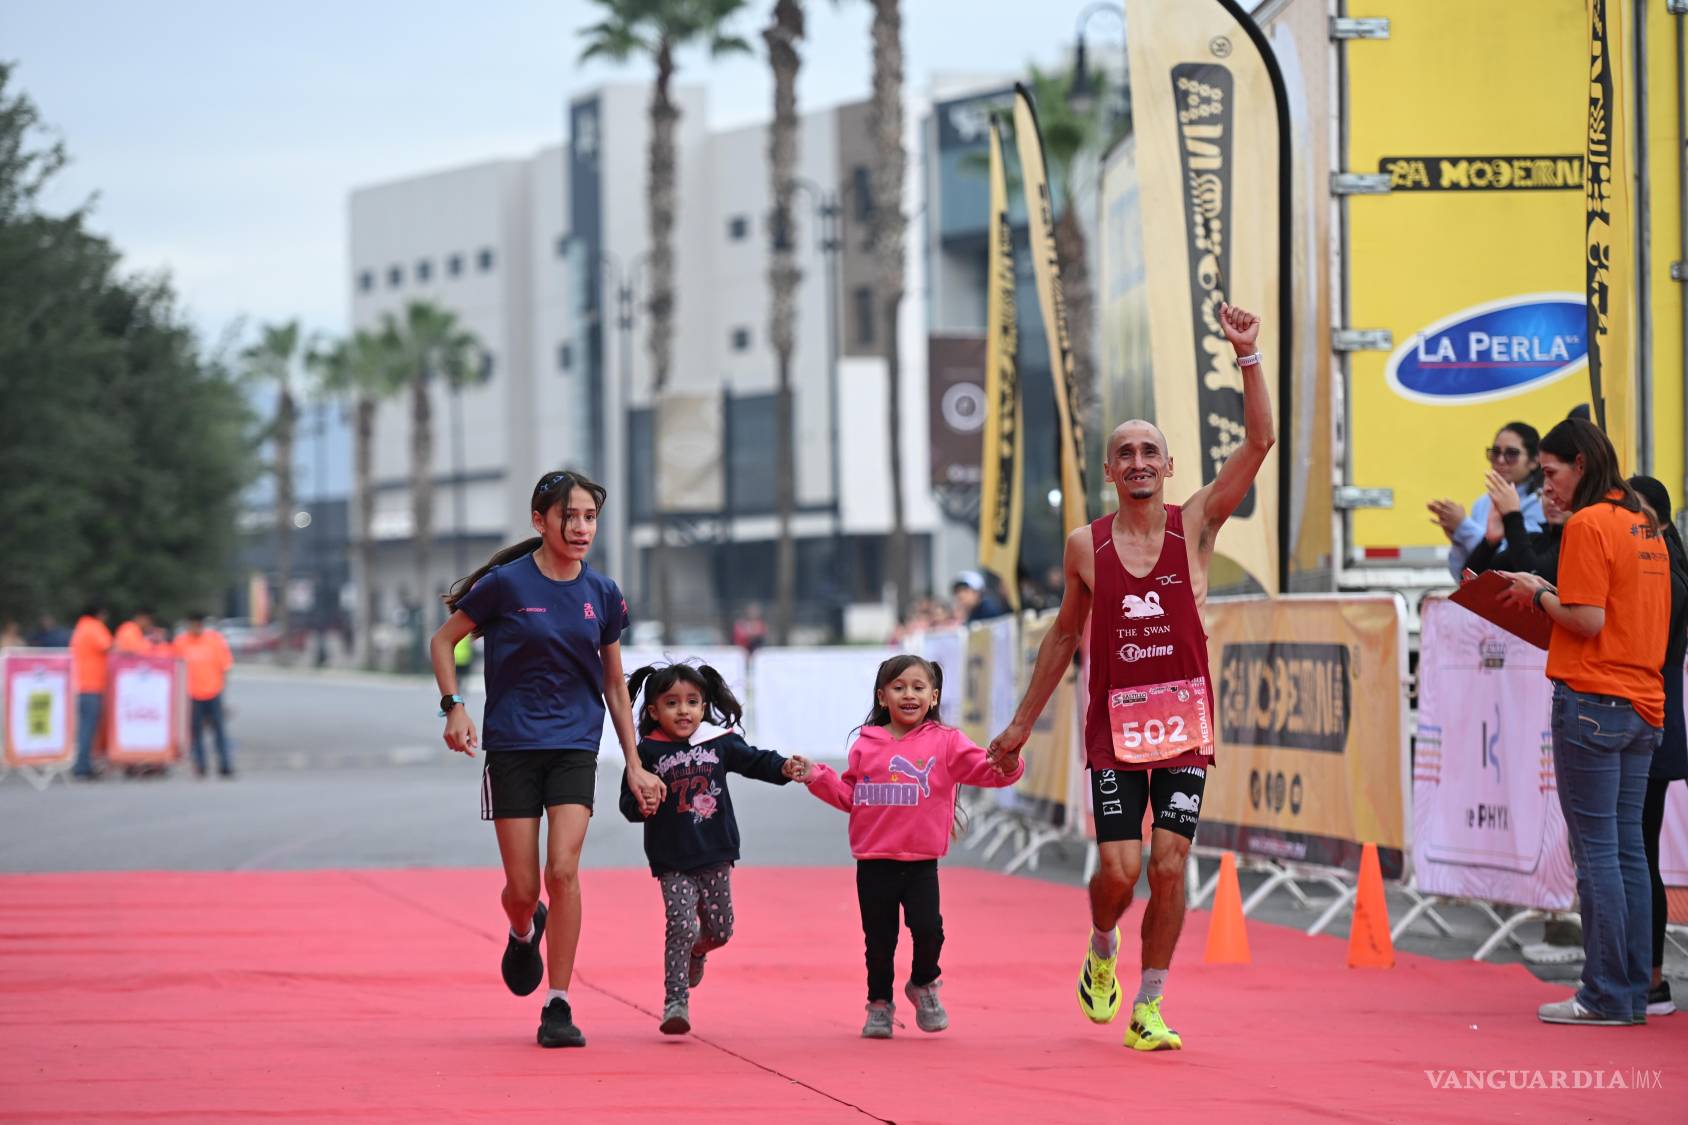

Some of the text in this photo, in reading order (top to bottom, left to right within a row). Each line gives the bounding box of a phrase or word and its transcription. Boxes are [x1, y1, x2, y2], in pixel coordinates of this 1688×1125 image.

[1439, 158, 1583, 188] MODERN
[1417, 330, 1570, 363] LA PERLA
[1116, 625, 1171, 639] THE SWAN
[1122, 715, 1188, 748] 502
[1196, 698, 1209, 744] MEDALLA
[853, 782, 919, 806] PUMA
[1100, 767, 1118, 794] Cis
